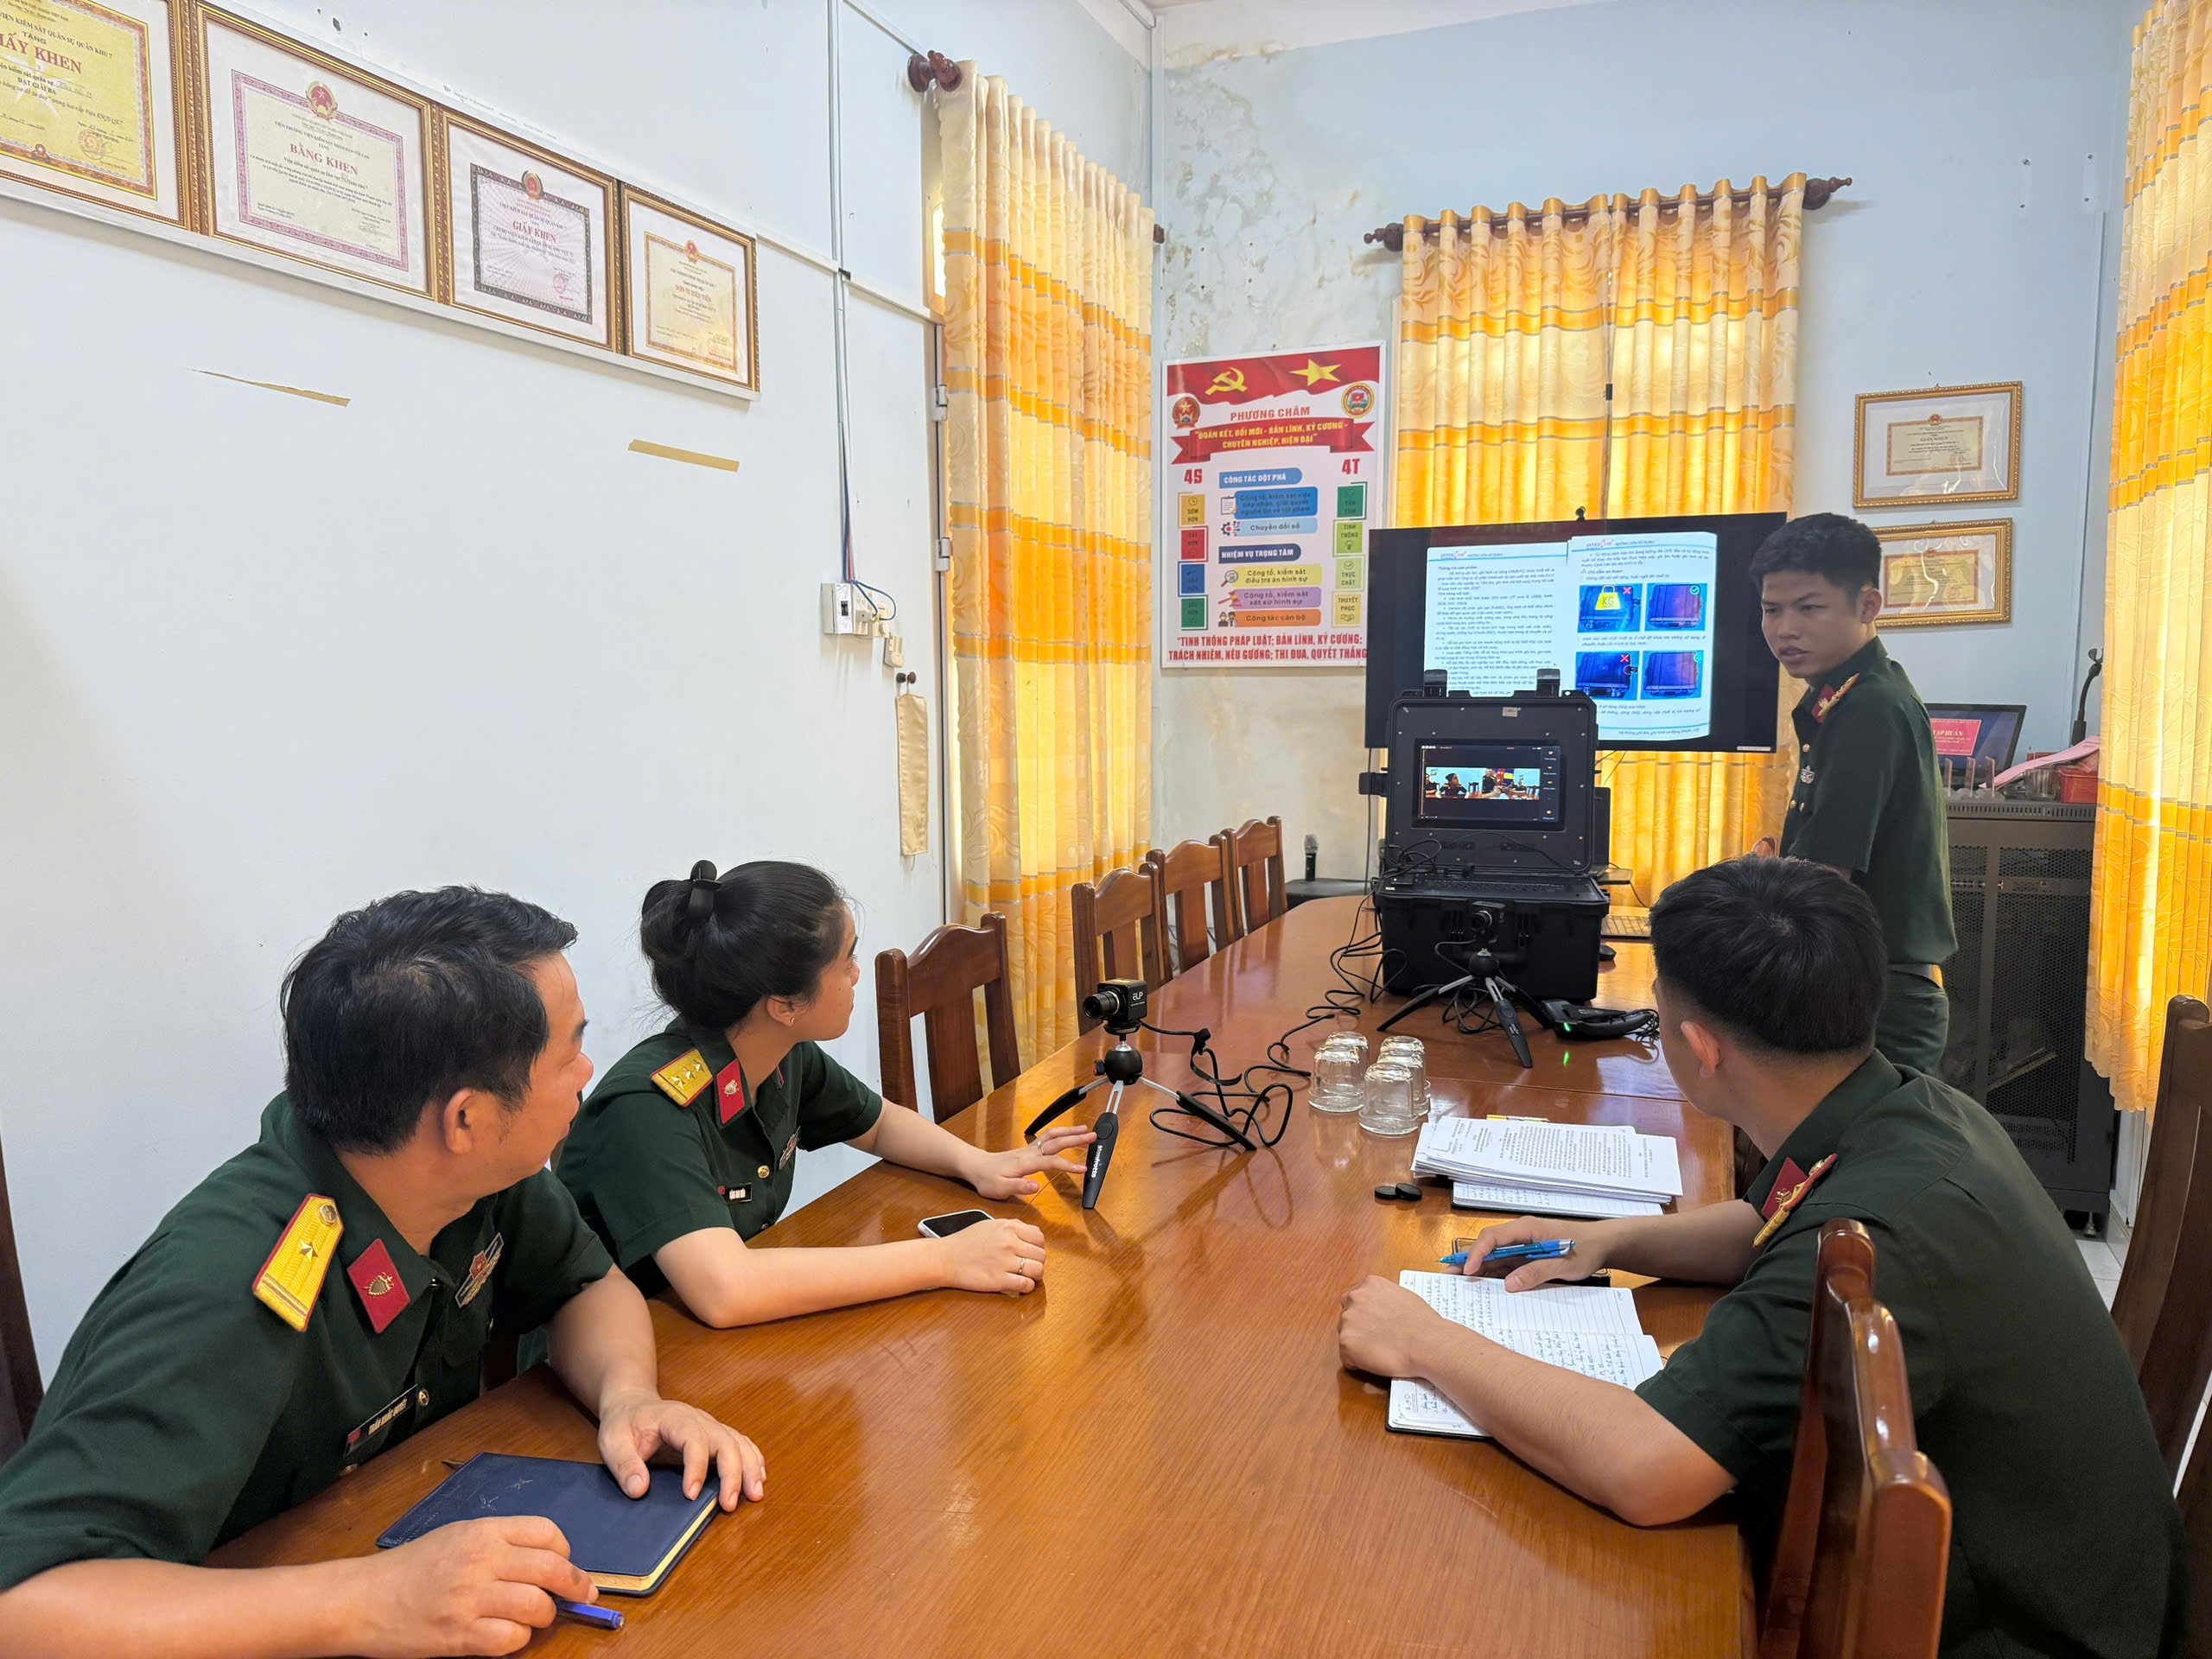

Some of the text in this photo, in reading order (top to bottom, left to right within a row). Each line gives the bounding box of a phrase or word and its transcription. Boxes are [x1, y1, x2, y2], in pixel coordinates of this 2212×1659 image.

[0, 32, 83, 74] IẤY KHEN
[289, 142, 324, 164] BẰNG
[325, 156, 359, 175] KHEN
[534, 228, 556, 242] KHEN
[1230, 409, 1274, 422] PHƯƠNG
[1317, 419, 1344, 431] CƯƠNG
[1223, 438, 1250, 448] CHUYÊN
[1281, 435, 1300, 446] HIỆN
[1341, 458, 1361, 475] 4T
[1184, 468, 1203, 485] 4S
[1224, 473, 1287, 484] CÔNG TÁC ĐỘT PHÁ
[1250, 524, 1277, 532] Chuyển
[1221, 547, 1294, 559] NHIỆM VỤ TRỌNG TÂM
[1245, 575, 1261, 584] điều
[1274, 597, 1291, 606] hình
[1293, 598, 1303, 607] sự
[1602, 596, 1614, 606] KG
[1201, 634, 1228, 647] THÔNG
[1230, 633, 1251, 646] PHÁP
[1275, 632, 1293, 645] BẢN
[1317, 632, 1328, 645] KỶ
[1168, 648, 1194, 661] TRÁCH
[1225, 647, 1241, 660] NÊU
[1275, 648, 1288, 659] THI
[1311, 646, 1337, 660] QUYẾT
[1132, 991, 1144, 1001] ELP
